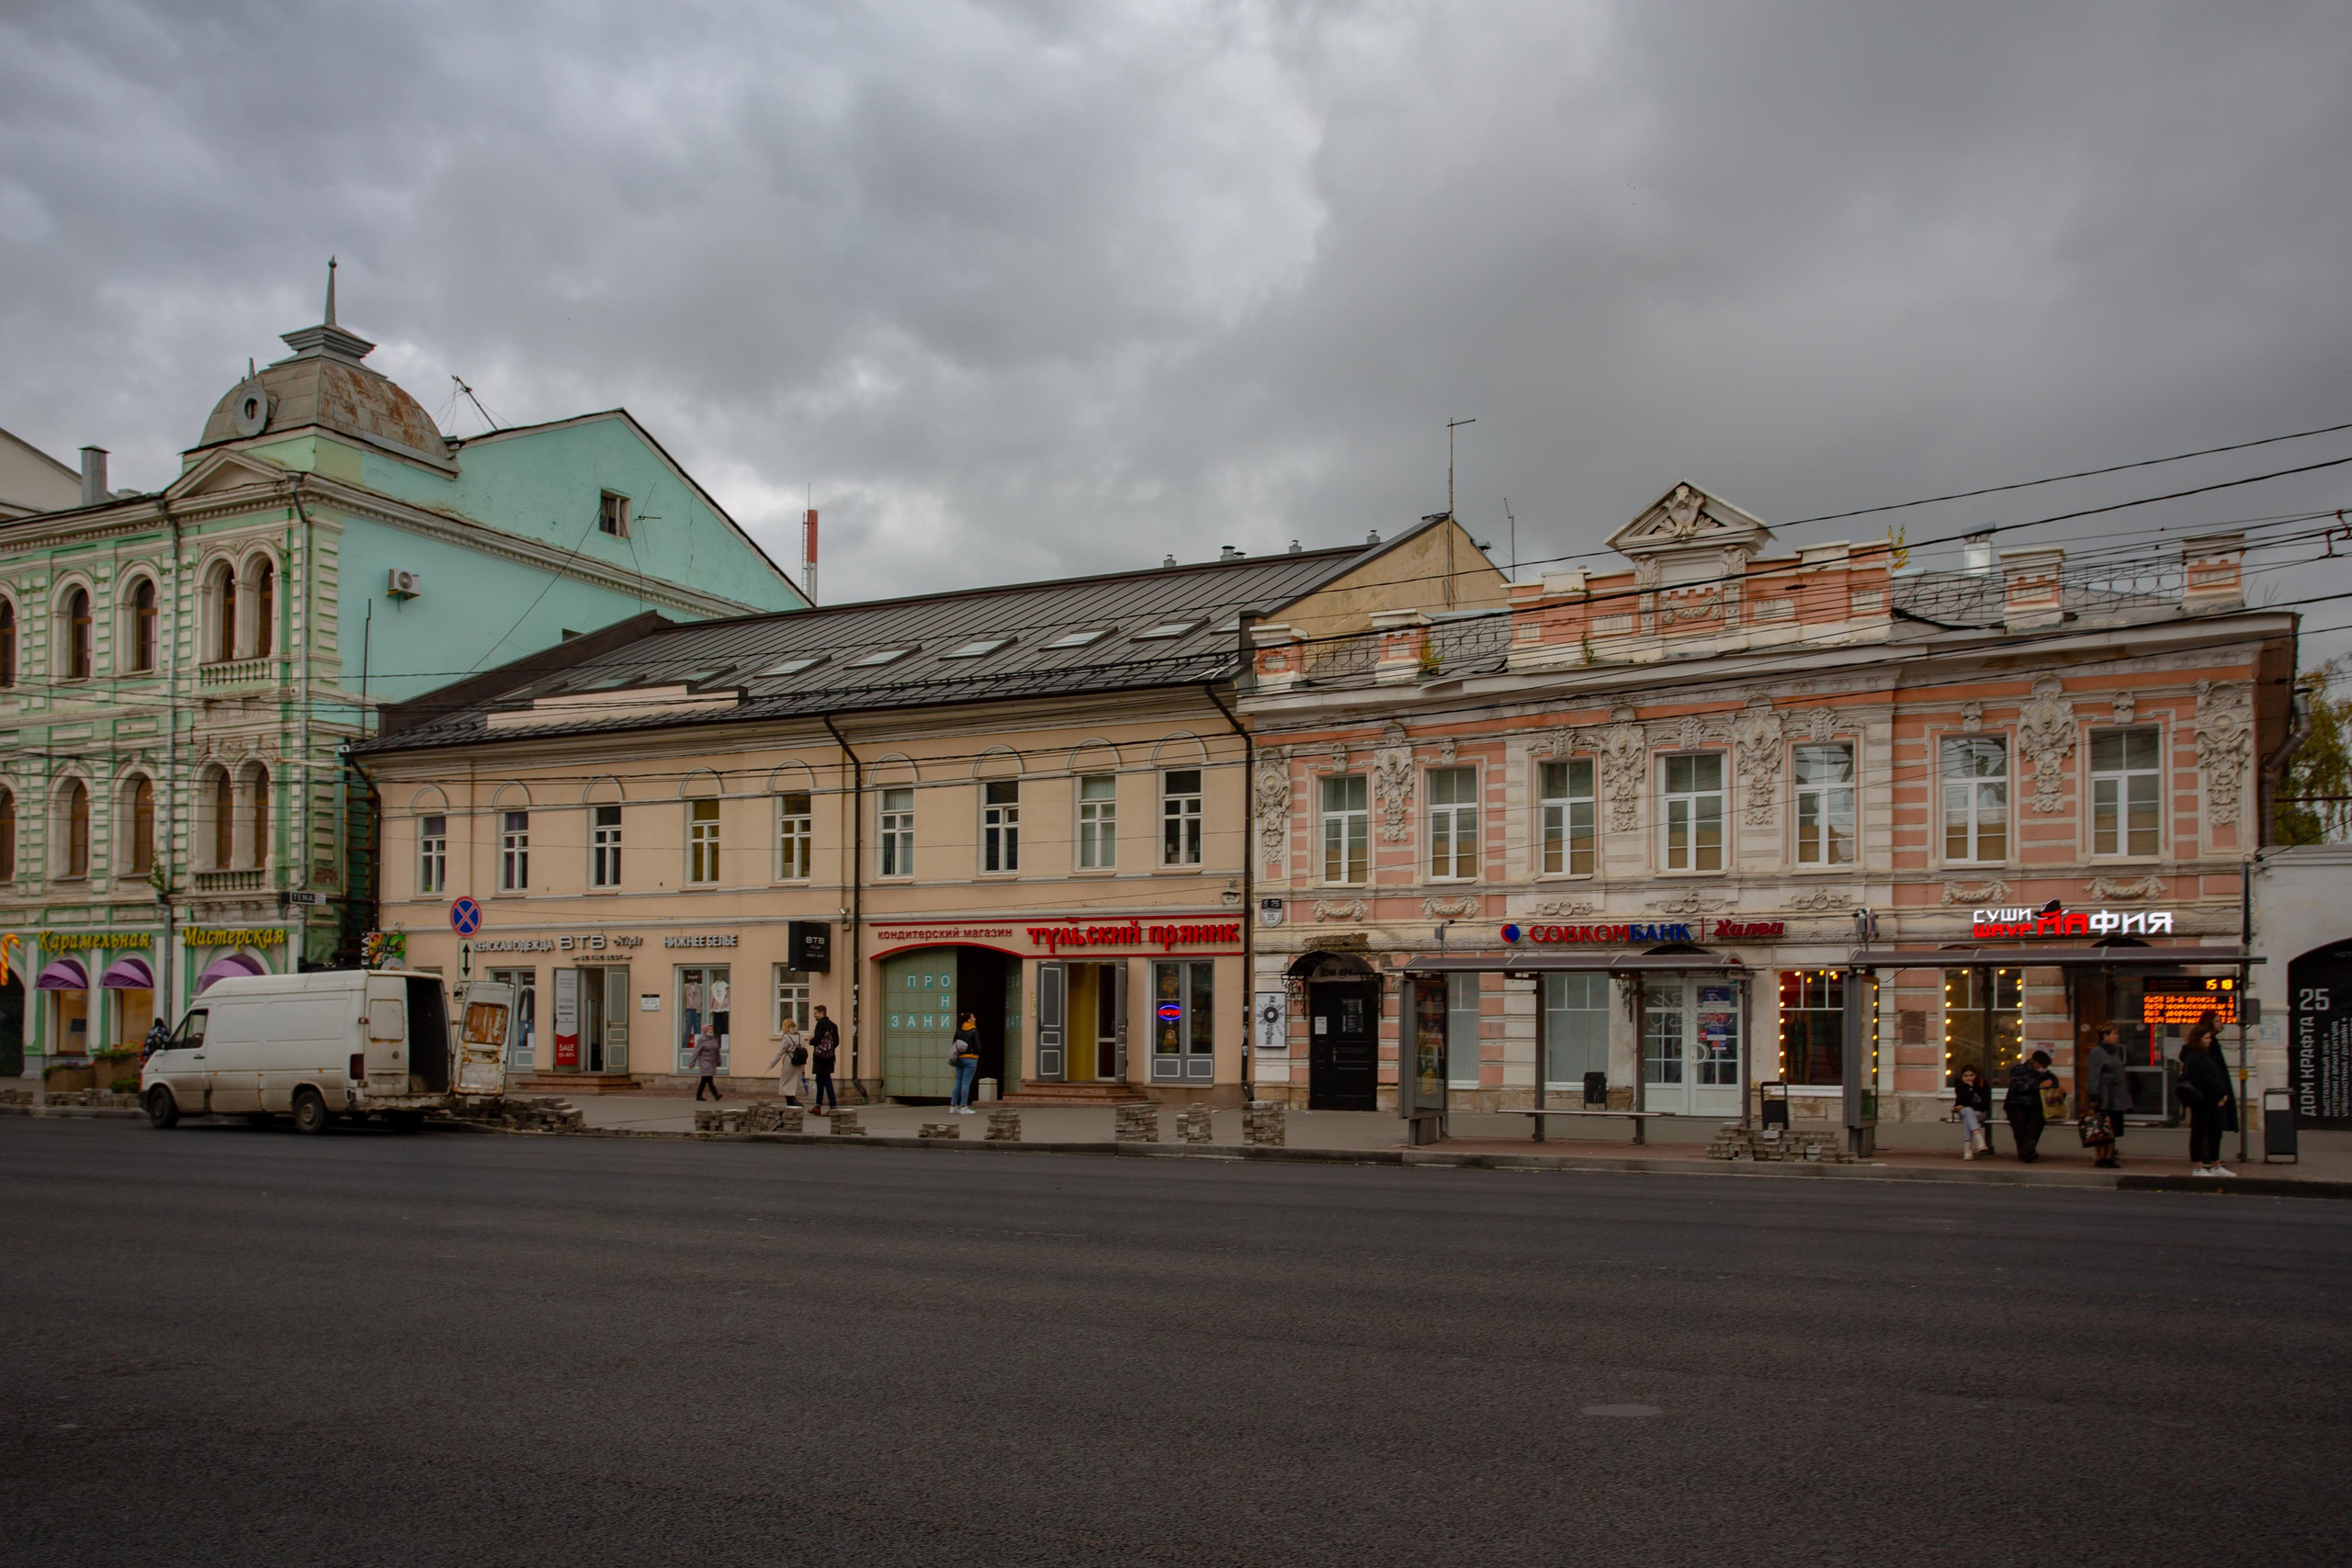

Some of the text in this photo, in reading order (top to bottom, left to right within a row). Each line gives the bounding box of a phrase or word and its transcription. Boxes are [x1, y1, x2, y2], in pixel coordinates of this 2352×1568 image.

[1271, 899, 1281, 908] 25
[1973, 908, 2174, 937] СУШИ МАФИЯ
[877, 926, 1012, 941] кондитерский магазин
[1530, 919, 1786, 943] СОВКОМБАНК Халва
[1973, 923, 2032, 938] ШАУР
[38, 926, 287, 955] Карамельная Мастерская
[514, 940, 555, 952] ОДЕЖДА
[663, 935, 738, 948] НИЖНЕЕ БЕЛЬЕ
[2299, 987, 2330, 1010] 25
[559, 1043, 574, 1052] SALE
[2300, 1016, 2317, 1116] ДОМ КРАФТА
